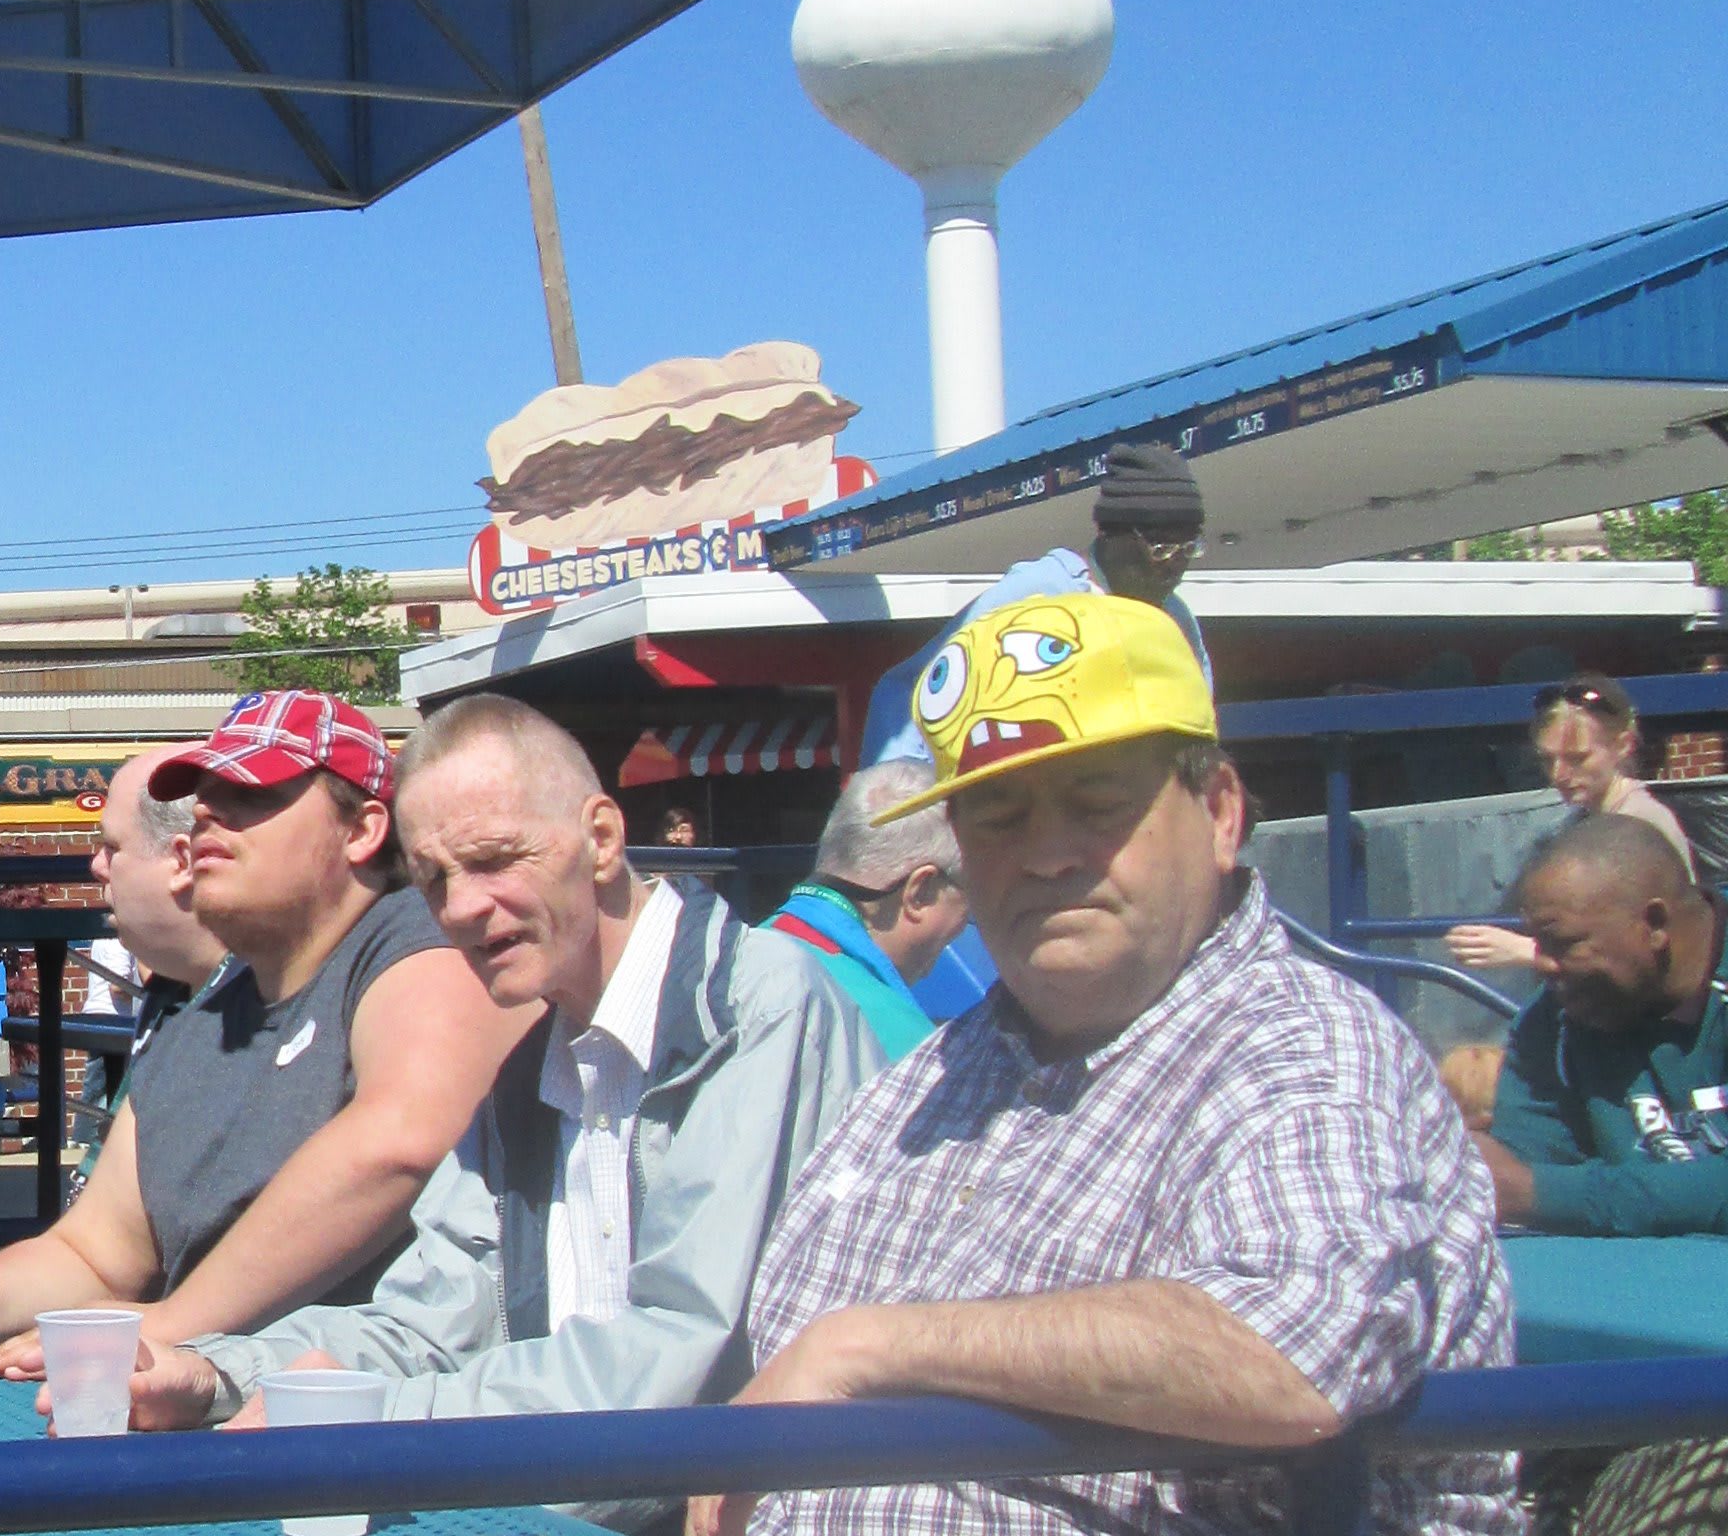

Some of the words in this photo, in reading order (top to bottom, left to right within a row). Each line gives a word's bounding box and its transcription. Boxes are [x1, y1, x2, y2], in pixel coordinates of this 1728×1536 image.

[491, 537, 703, 601] CHEESESTEAKS
[737, 529, 763, 560] M
[4, 764, 114, 797] GRA
